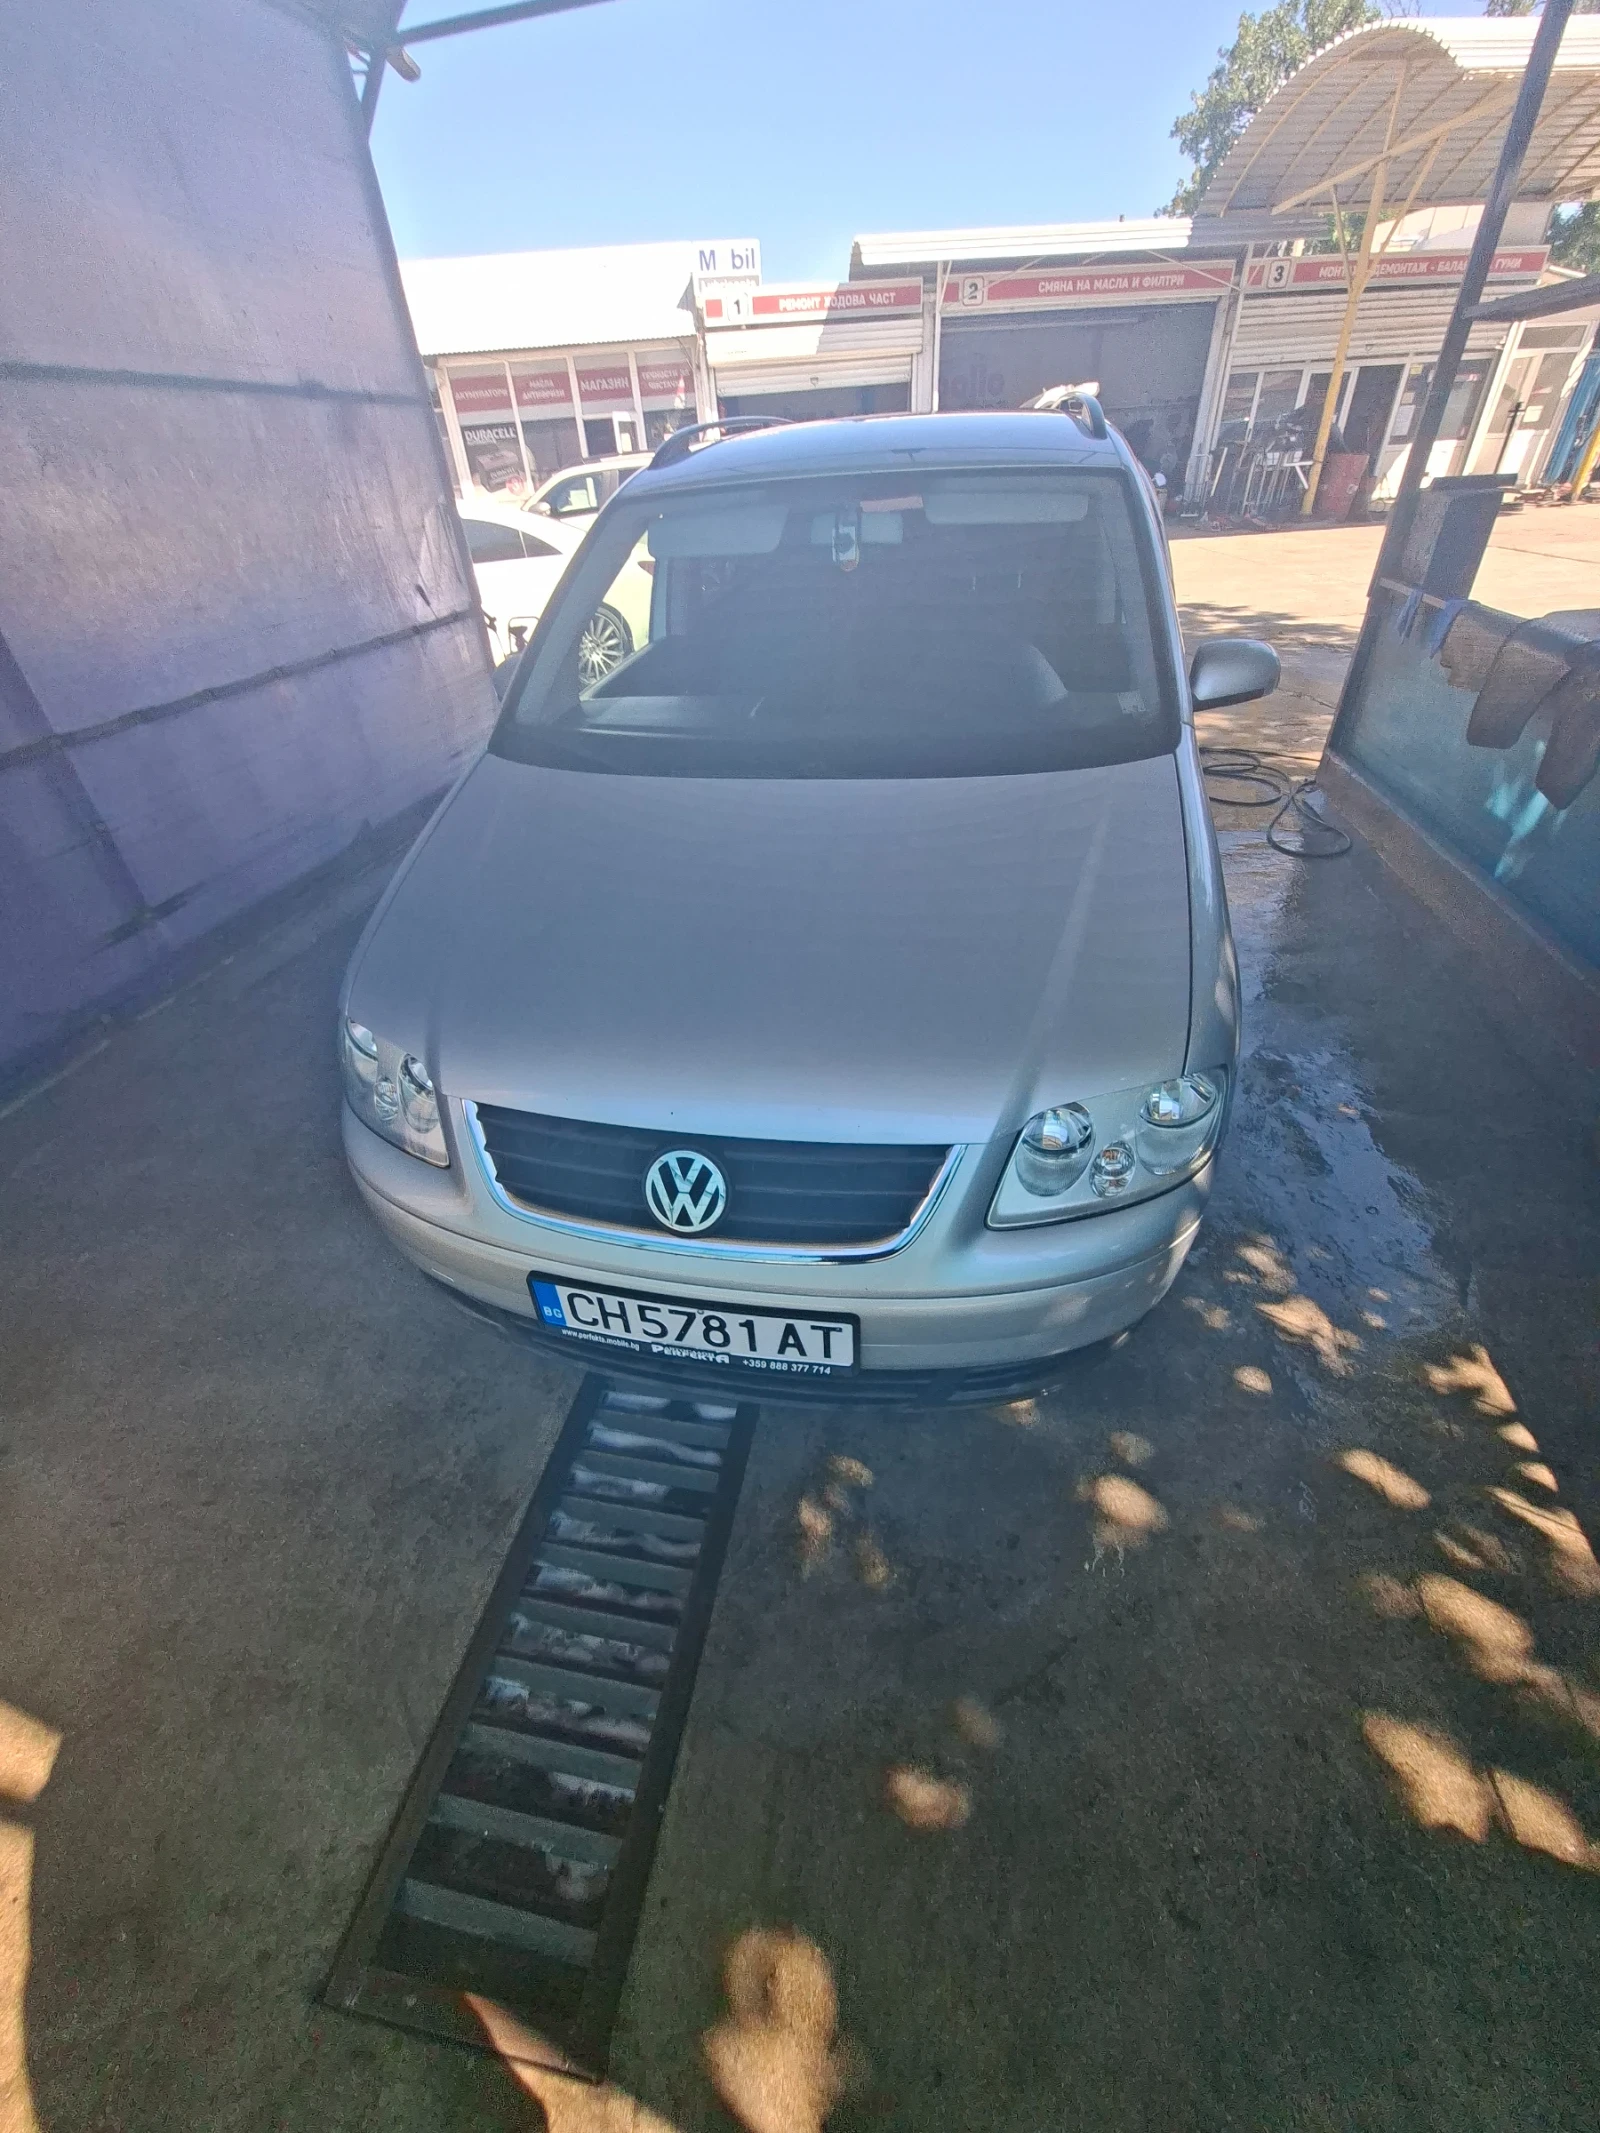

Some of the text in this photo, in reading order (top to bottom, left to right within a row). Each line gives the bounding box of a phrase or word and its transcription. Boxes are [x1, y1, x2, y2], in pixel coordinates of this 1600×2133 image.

[699, 248, 755, 271] Mbil
[1274, 265, 1284, 282] 3
[967, 275, 1185, 300] 2 СМЯНА НА МАСЛА И ФИЛТРИ
[733, 299, 741, 315] 1
[779, 298, 821, 312] РЕМОНТ
[869, 292, 896, 305] ЧАСТ
[580, 377, 629, 391] МАГАЗИН
[463, 426, 517, 443] DURACELL
[543, 1306, 562, 1318] BG
[742, 1359, 767, 1369] +359
[769, 1361, 788, 1371] 888
[790, 1363, 809, 1373] 377
[812, 1365, 831, 1375] 714
